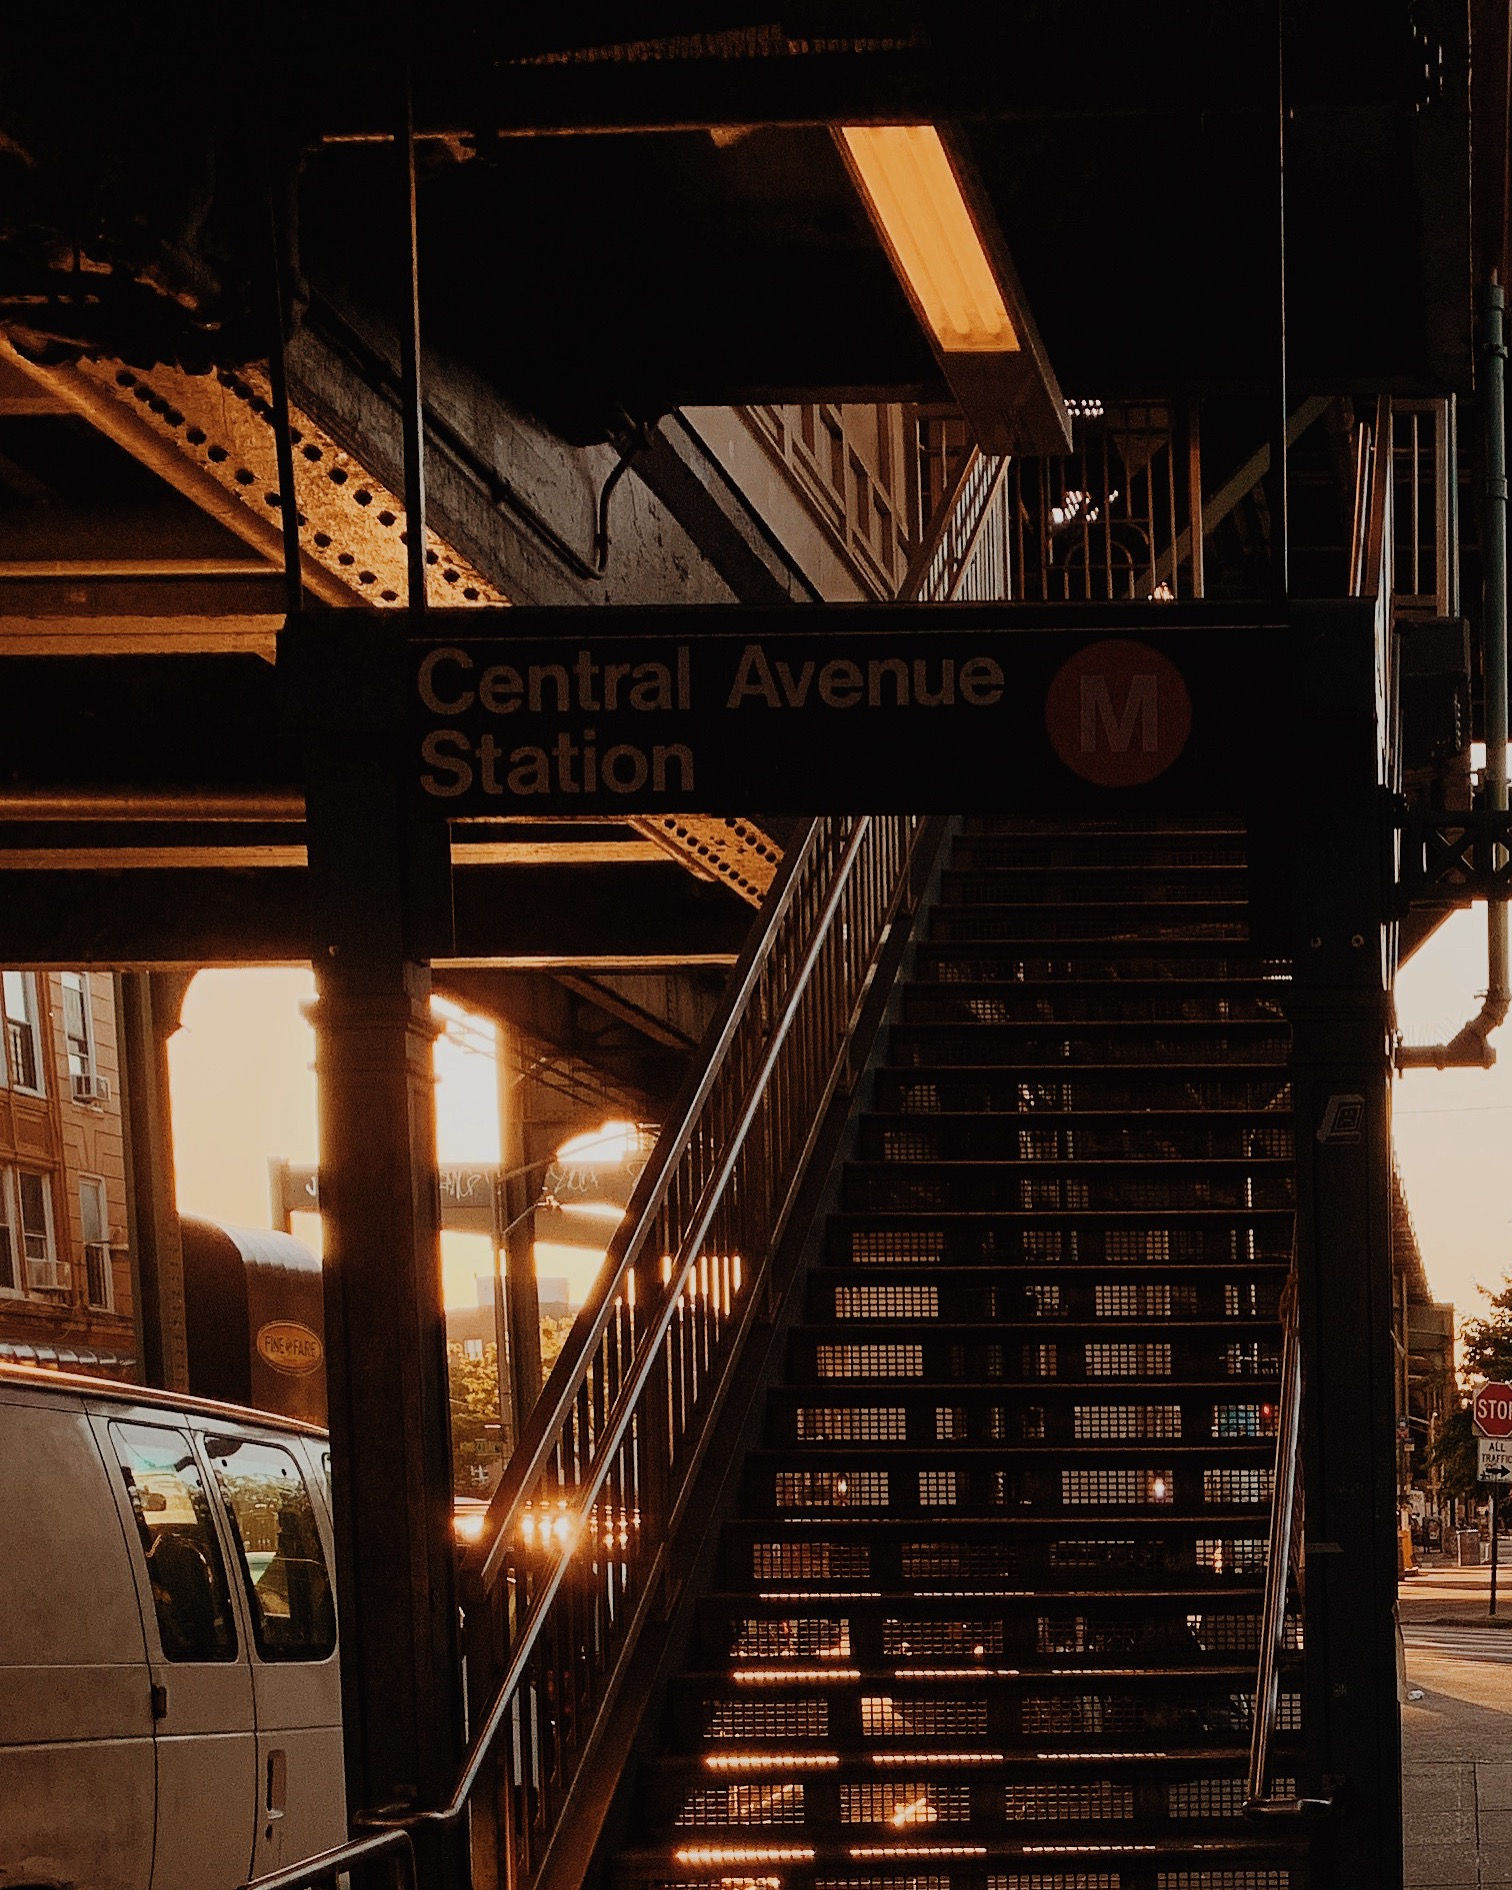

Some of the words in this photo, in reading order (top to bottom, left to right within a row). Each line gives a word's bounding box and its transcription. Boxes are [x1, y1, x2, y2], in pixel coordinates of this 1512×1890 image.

[416, 645, 693, 716] Central
[725, 644, 1006, 710] Avenue
[1079, 672, 1160, 753] M
[419, 726, 696, 797] Station
[264, 1335, 285, 1354] FINE
[293, 1339, 317, 1358] FARE
[1481, 1453, 1512, 1464] TRAFFIC
[1488, 1442, 1506, 1453] ALL
